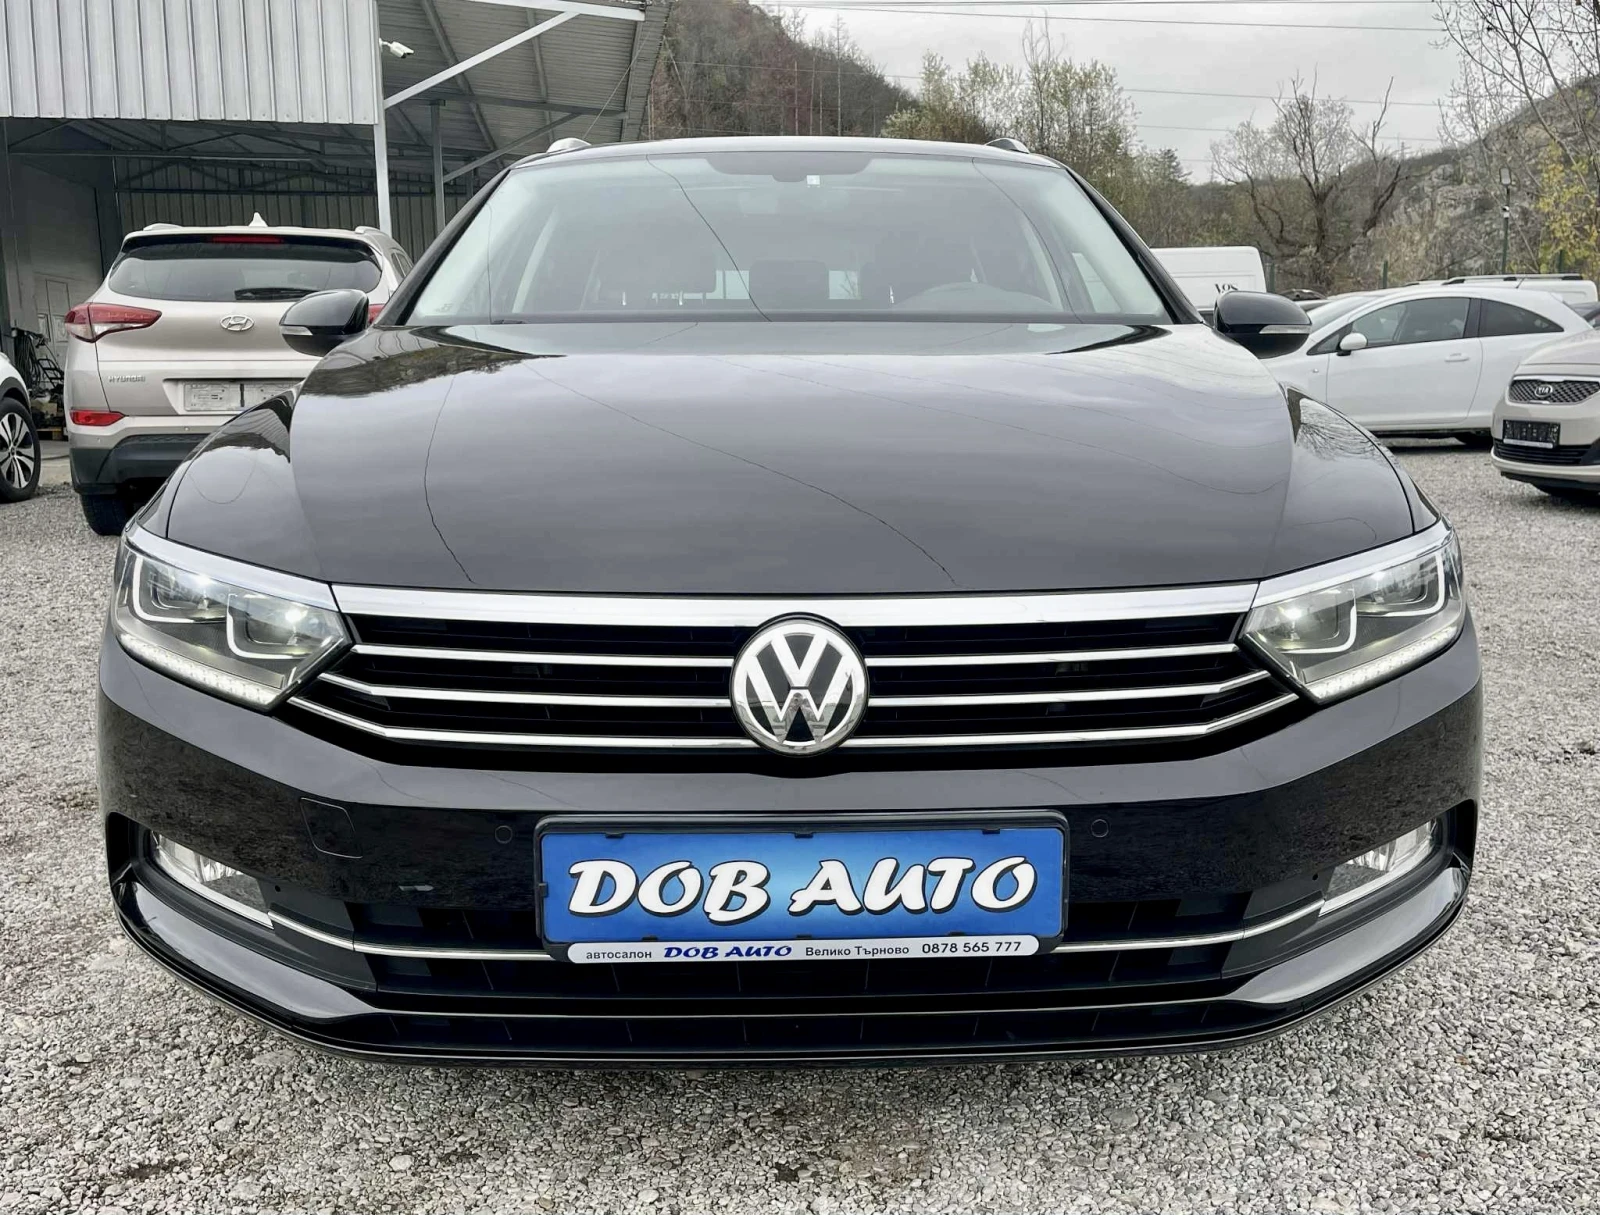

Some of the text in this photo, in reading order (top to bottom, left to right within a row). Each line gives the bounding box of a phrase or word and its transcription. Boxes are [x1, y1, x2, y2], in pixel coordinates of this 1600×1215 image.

[568, 856, 1038, 926] DOB AUTO
[585, 940, 1022, 960] автосалон DOB AUTO Велико Търново 0878 565 777
